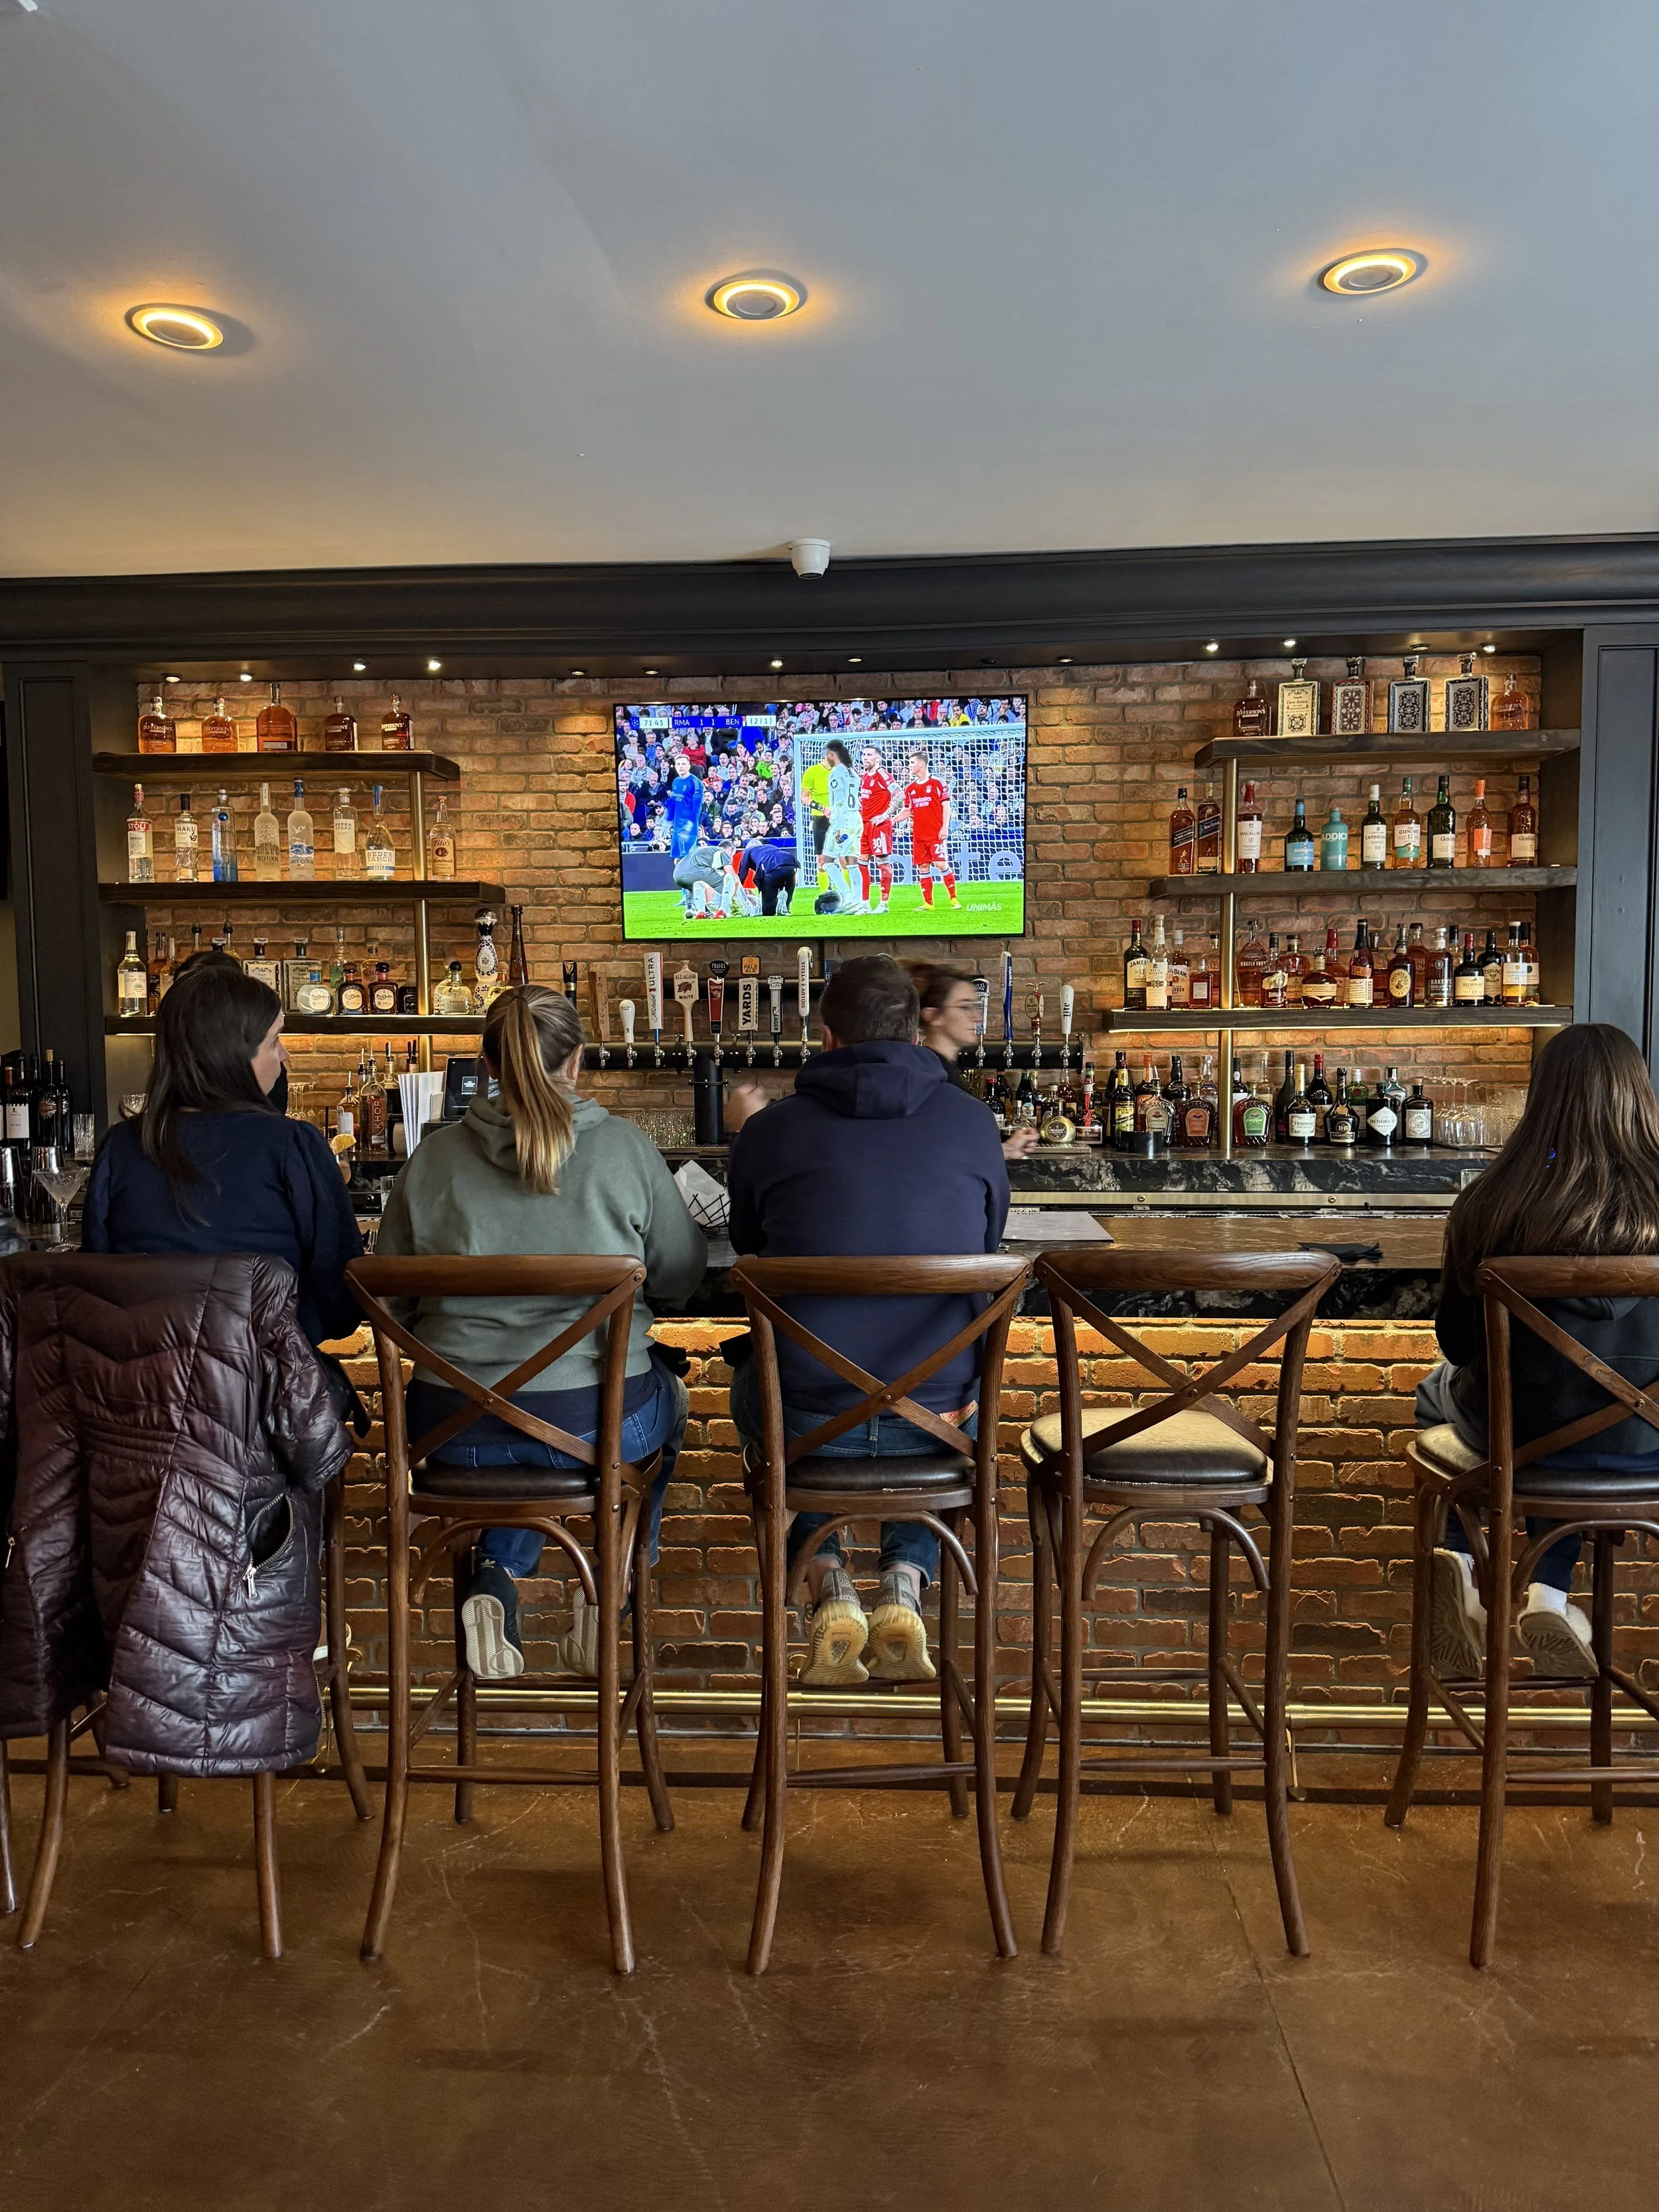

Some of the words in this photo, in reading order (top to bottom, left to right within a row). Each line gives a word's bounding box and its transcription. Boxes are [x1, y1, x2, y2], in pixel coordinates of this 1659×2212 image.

[177, 826, 196, 835] HAKU
[872, 839, 881, 848] 30
[1174, 968, 1187, 978] BEAM
[743, 984, 751, 1025] YARDS
